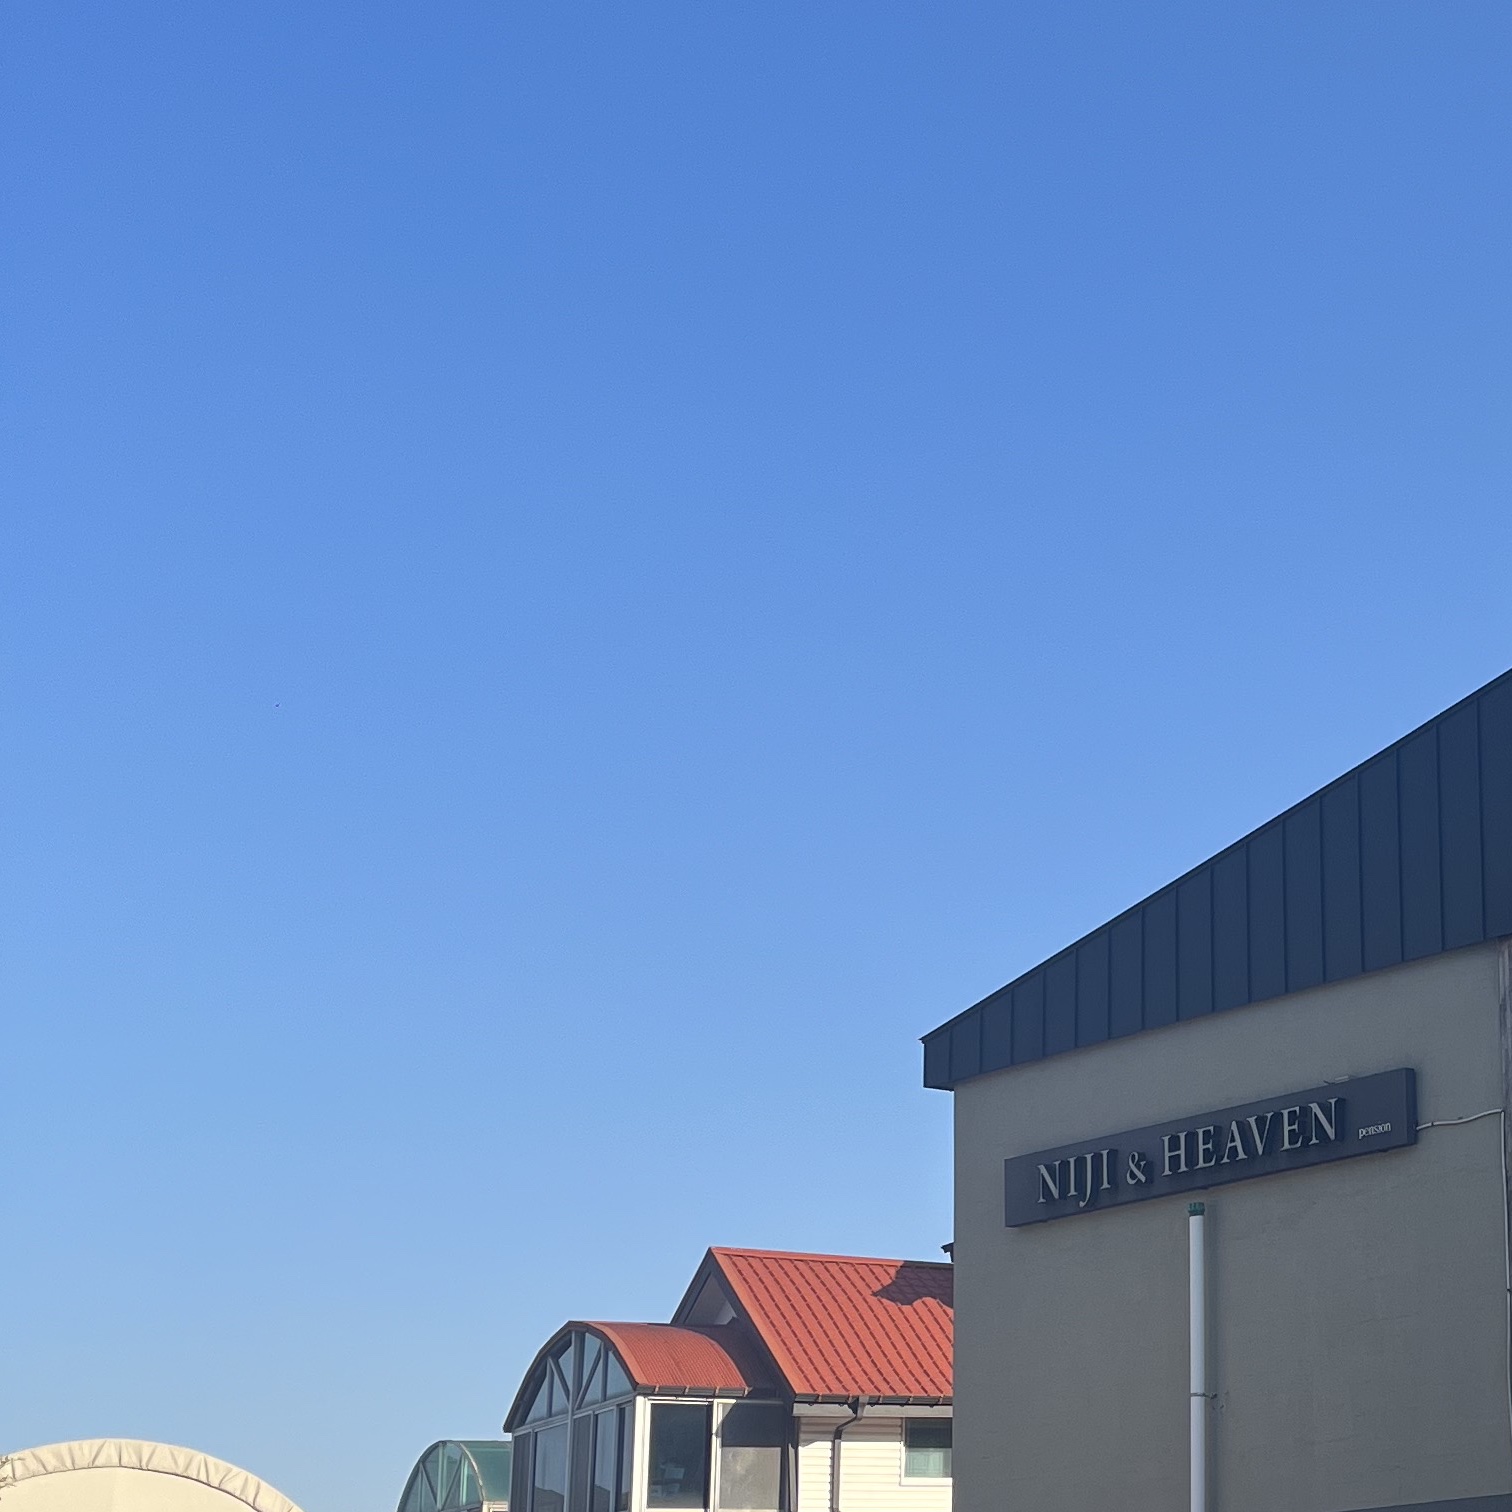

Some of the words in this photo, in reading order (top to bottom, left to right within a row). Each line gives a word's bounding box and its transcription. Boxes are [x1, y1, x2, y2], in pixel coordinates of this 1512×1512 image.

[1037, 1149, 1111, 1207] NIJI
[1126, 1151, 1147, 1185] &
[1161, 1097, 1340, 1177] HEAVEN
[1358, 1122, 1392, 1140] pension
